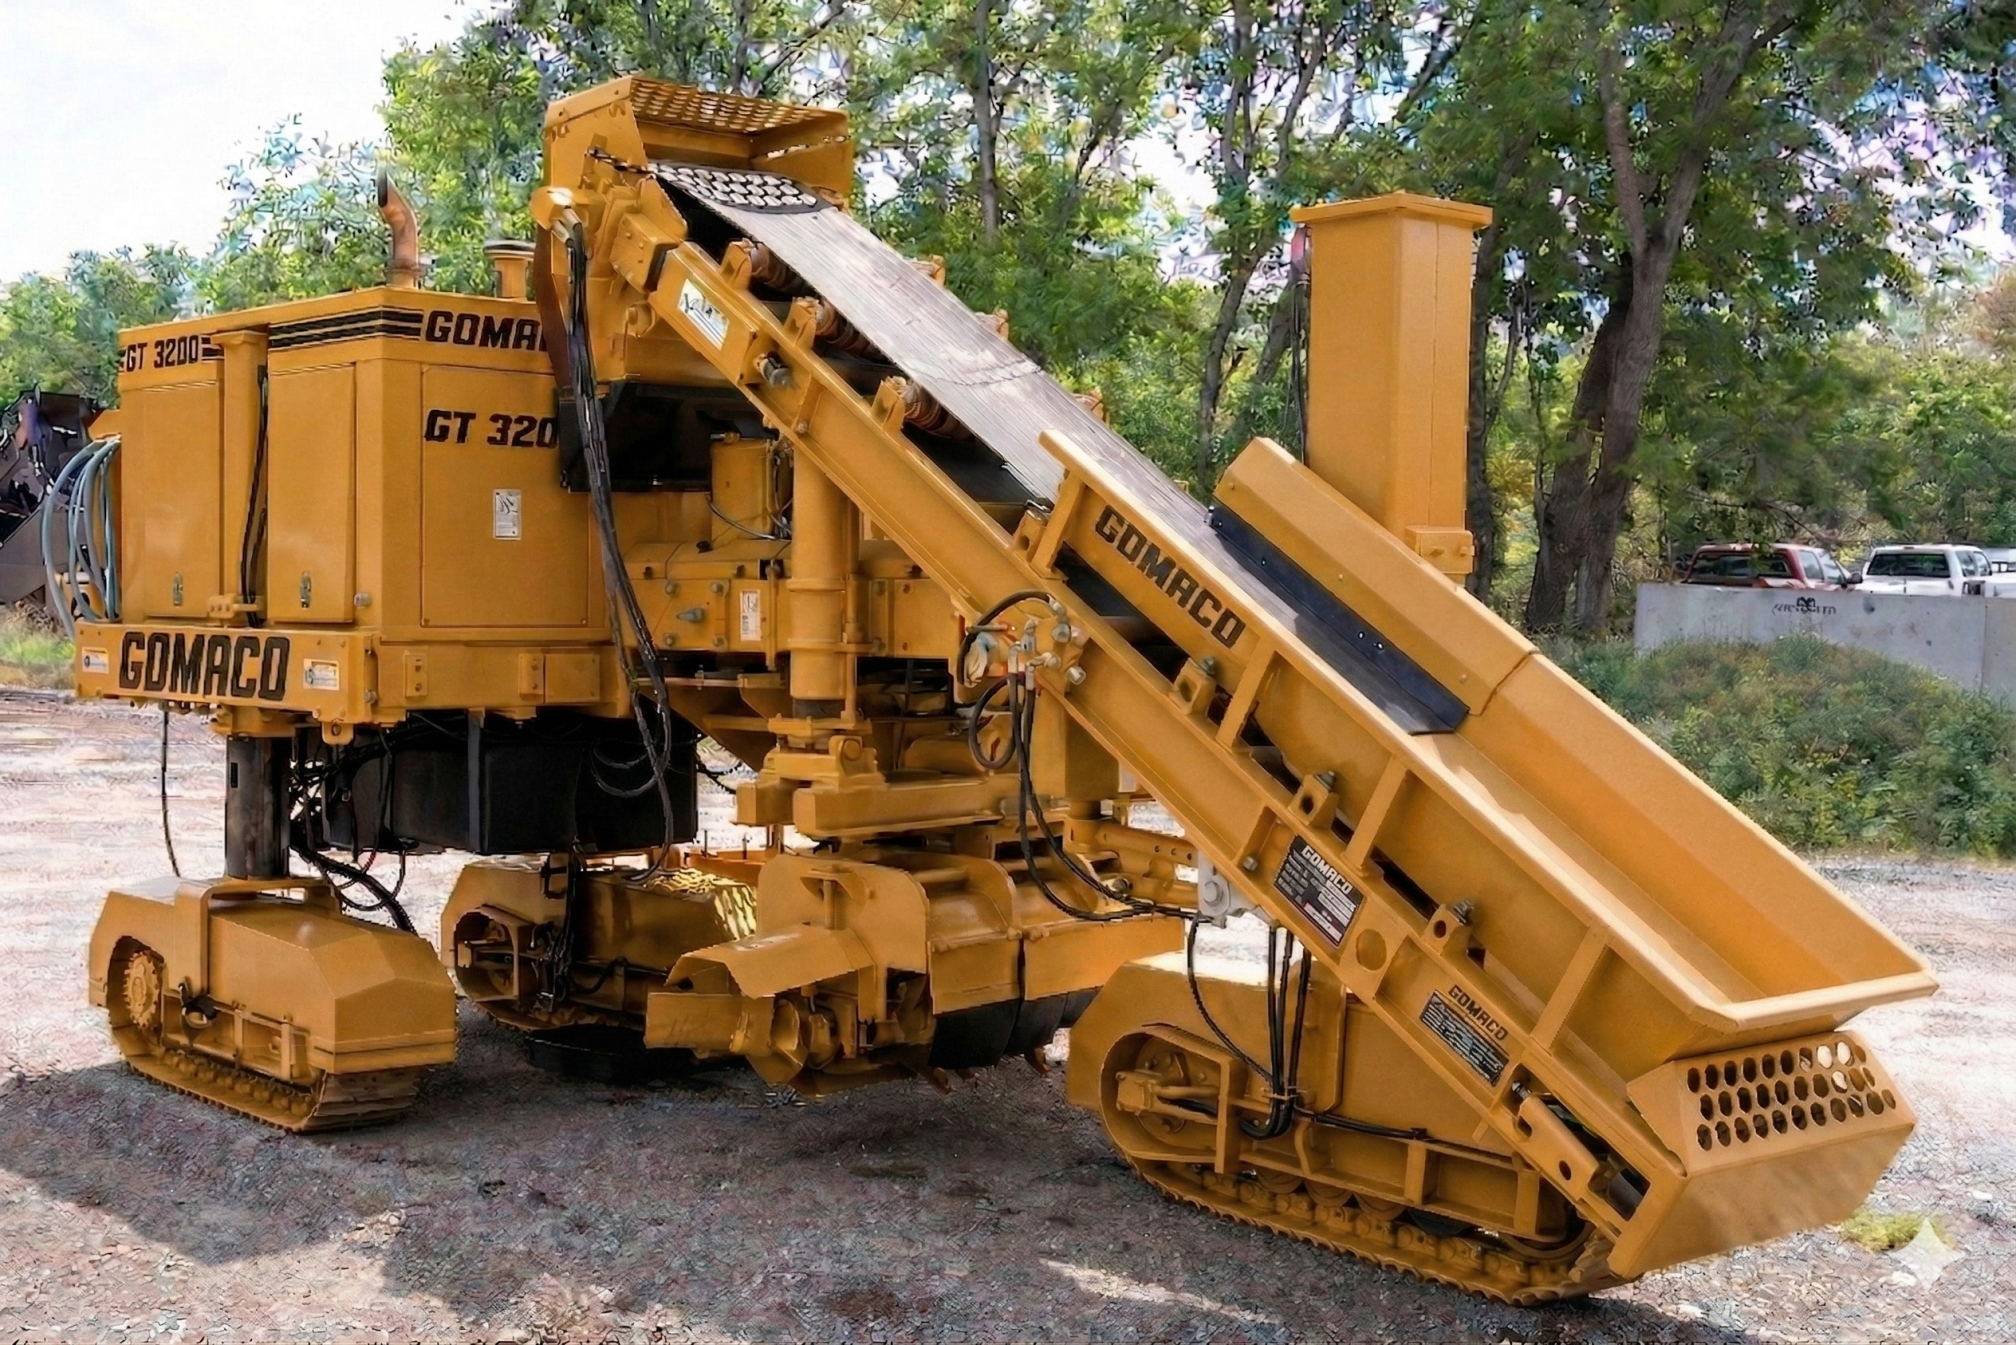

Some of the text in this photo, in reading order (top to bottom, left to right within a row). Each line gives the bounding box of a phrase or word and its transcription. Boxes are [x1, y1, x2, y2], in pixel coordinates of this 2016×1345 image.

[126, 335, 199, 372] GT 3200
[425, 310, 548, 352] GOMA
[424, 409, 559, 449] GT 320
[1095, 504, 1247, 650] GOMACO
[119, 631, 290, 701] GOMACO
[1301, 844, 1354, 895] GOMACO
[1448, 984, 1509, 1041] GOMACO
